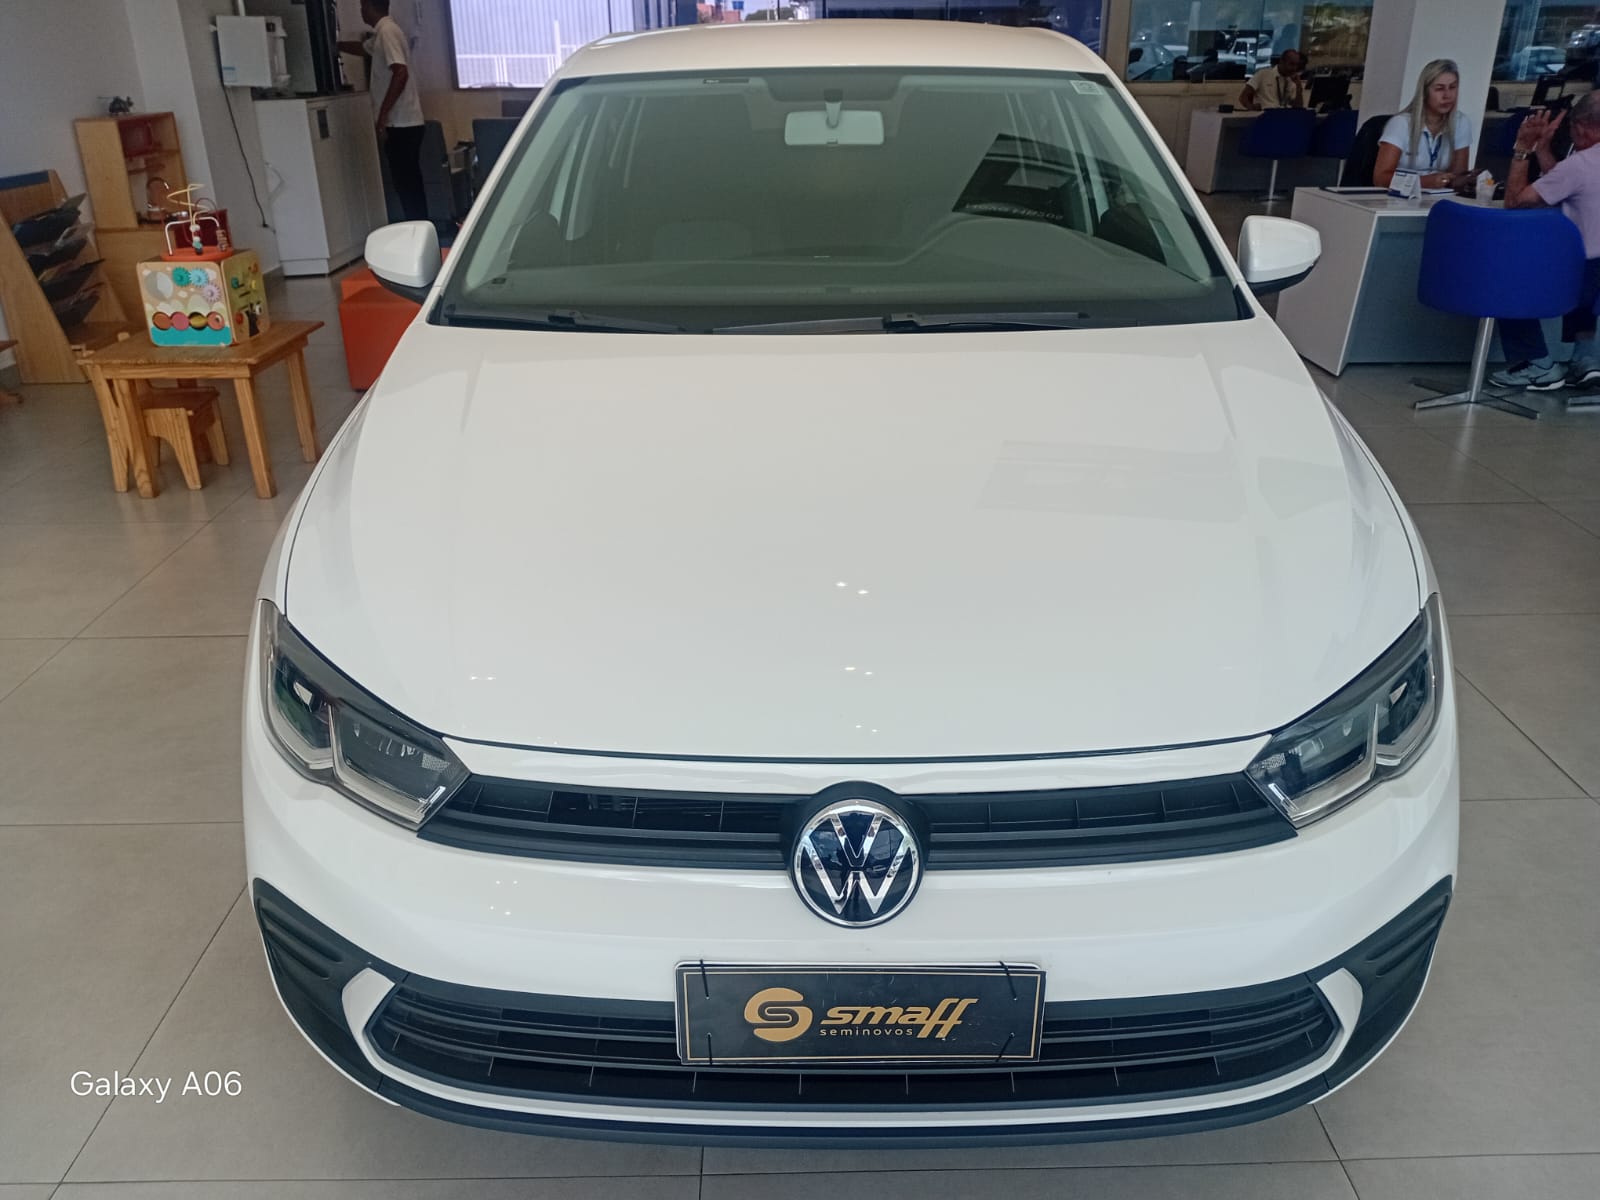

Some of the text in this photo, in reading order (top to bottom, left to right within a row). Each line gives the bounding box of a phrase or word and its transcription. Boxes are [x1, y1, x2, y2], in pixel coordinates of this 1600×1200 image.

[797, 806, 914, 915] VW
[819, 1026, 913, 1037] seminovos
[821, 998, 979, 1038] smaff
